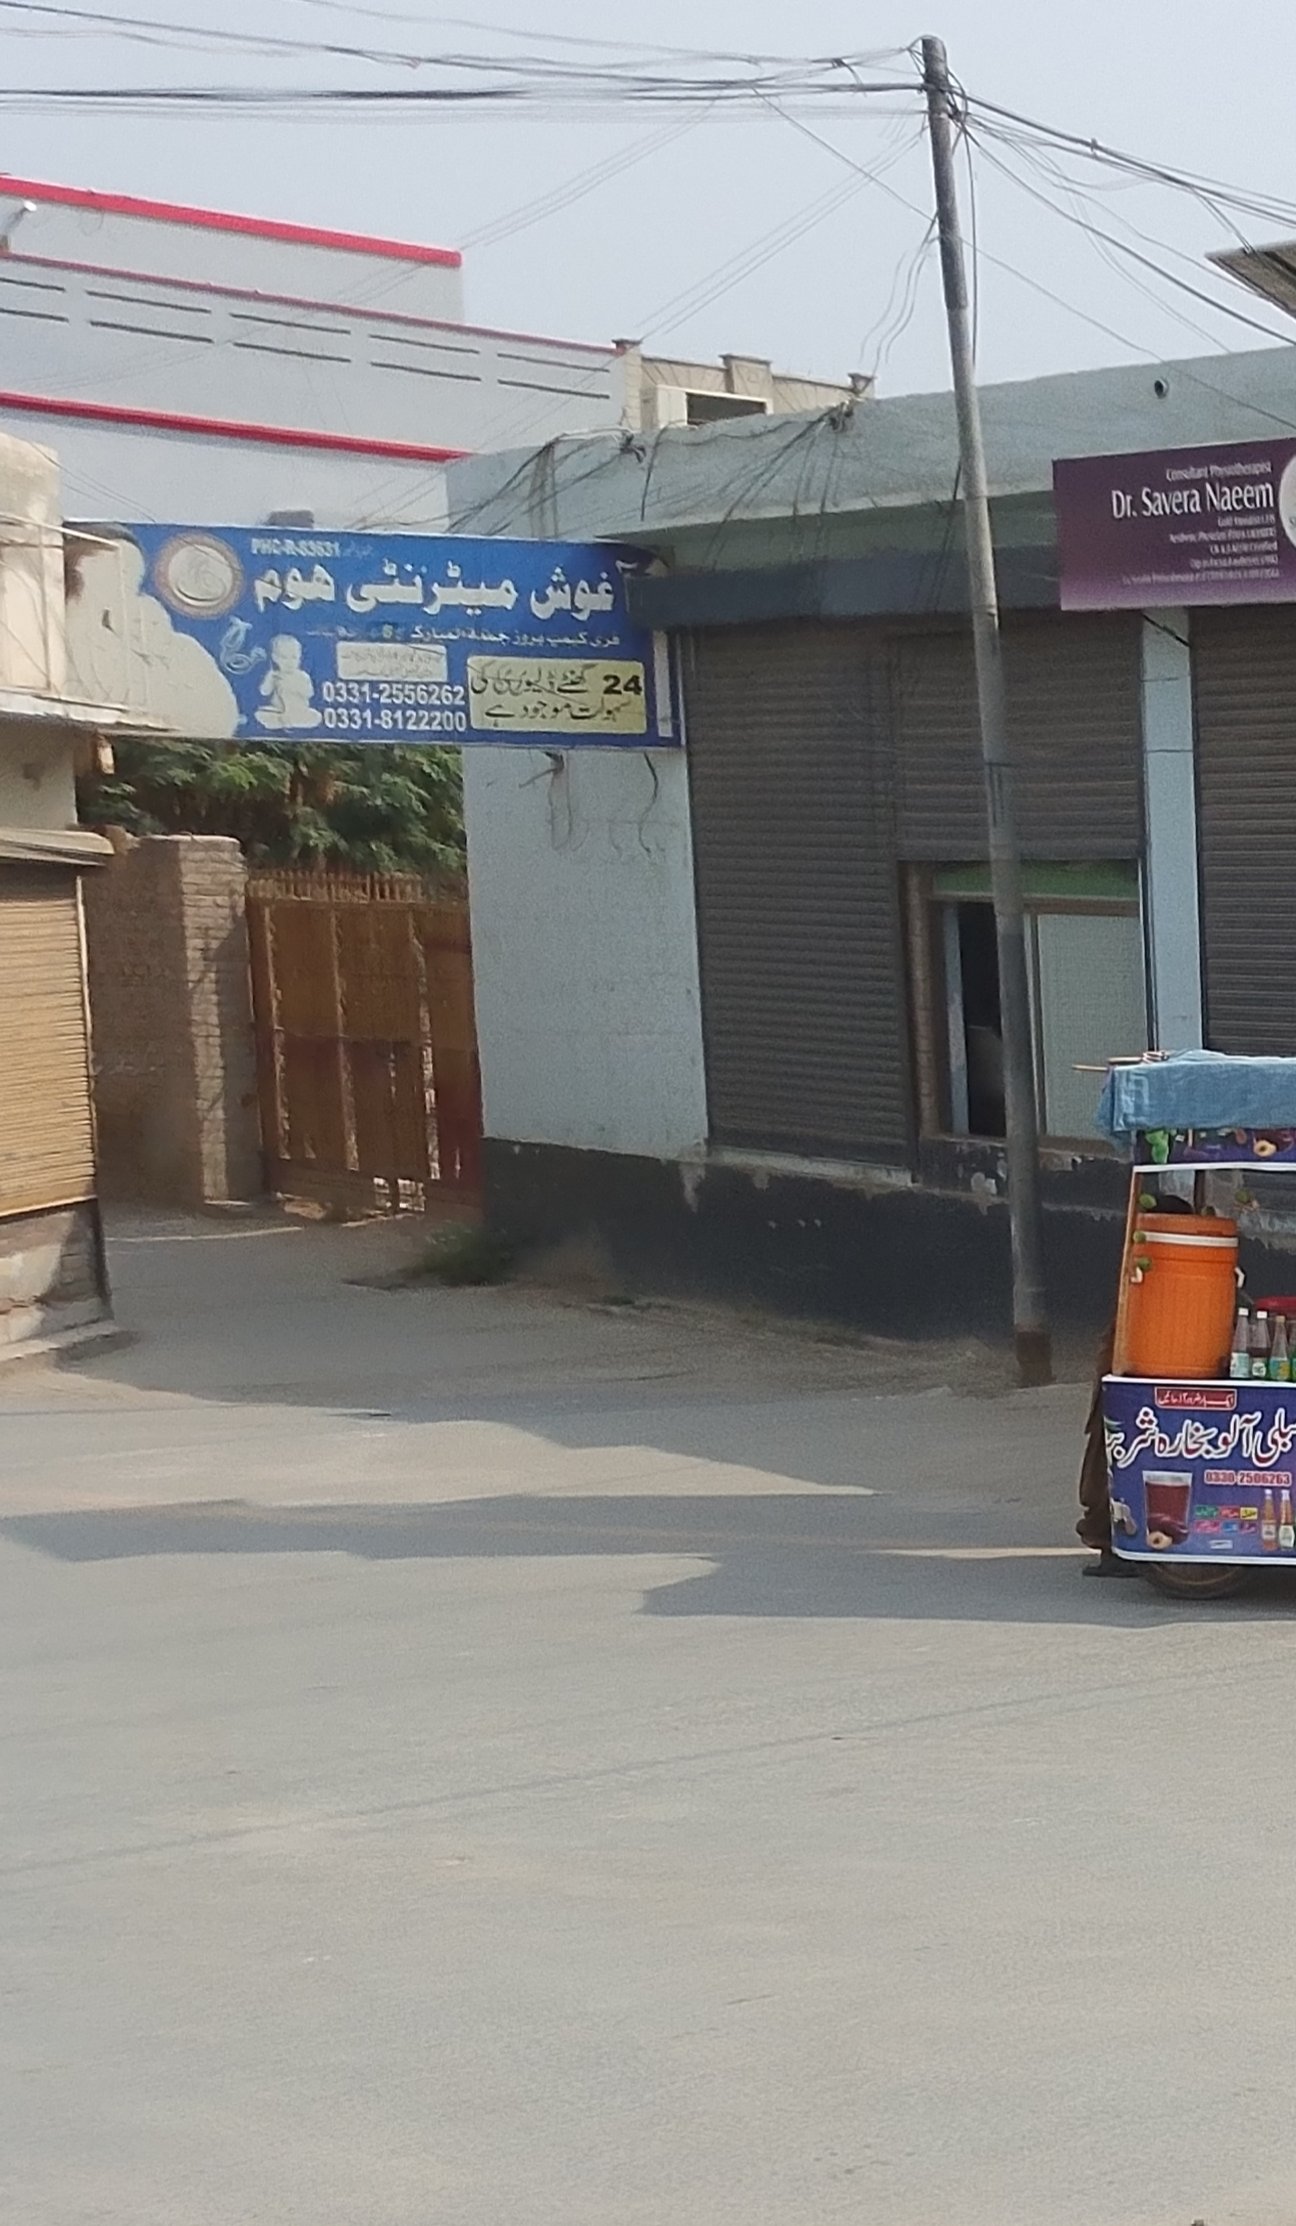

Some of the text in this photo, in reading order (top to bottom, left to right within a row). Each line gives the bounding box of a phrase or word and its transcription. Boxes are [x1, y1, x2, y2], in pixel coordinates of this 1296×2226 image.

[1111, 482, 1275, 519] Dr. Savera Naeem
[322, 681, 466, 706] 0331-2556262
[602, 674, 643, 696] 24
[323, 707, 468, 732] 0331-8122200
